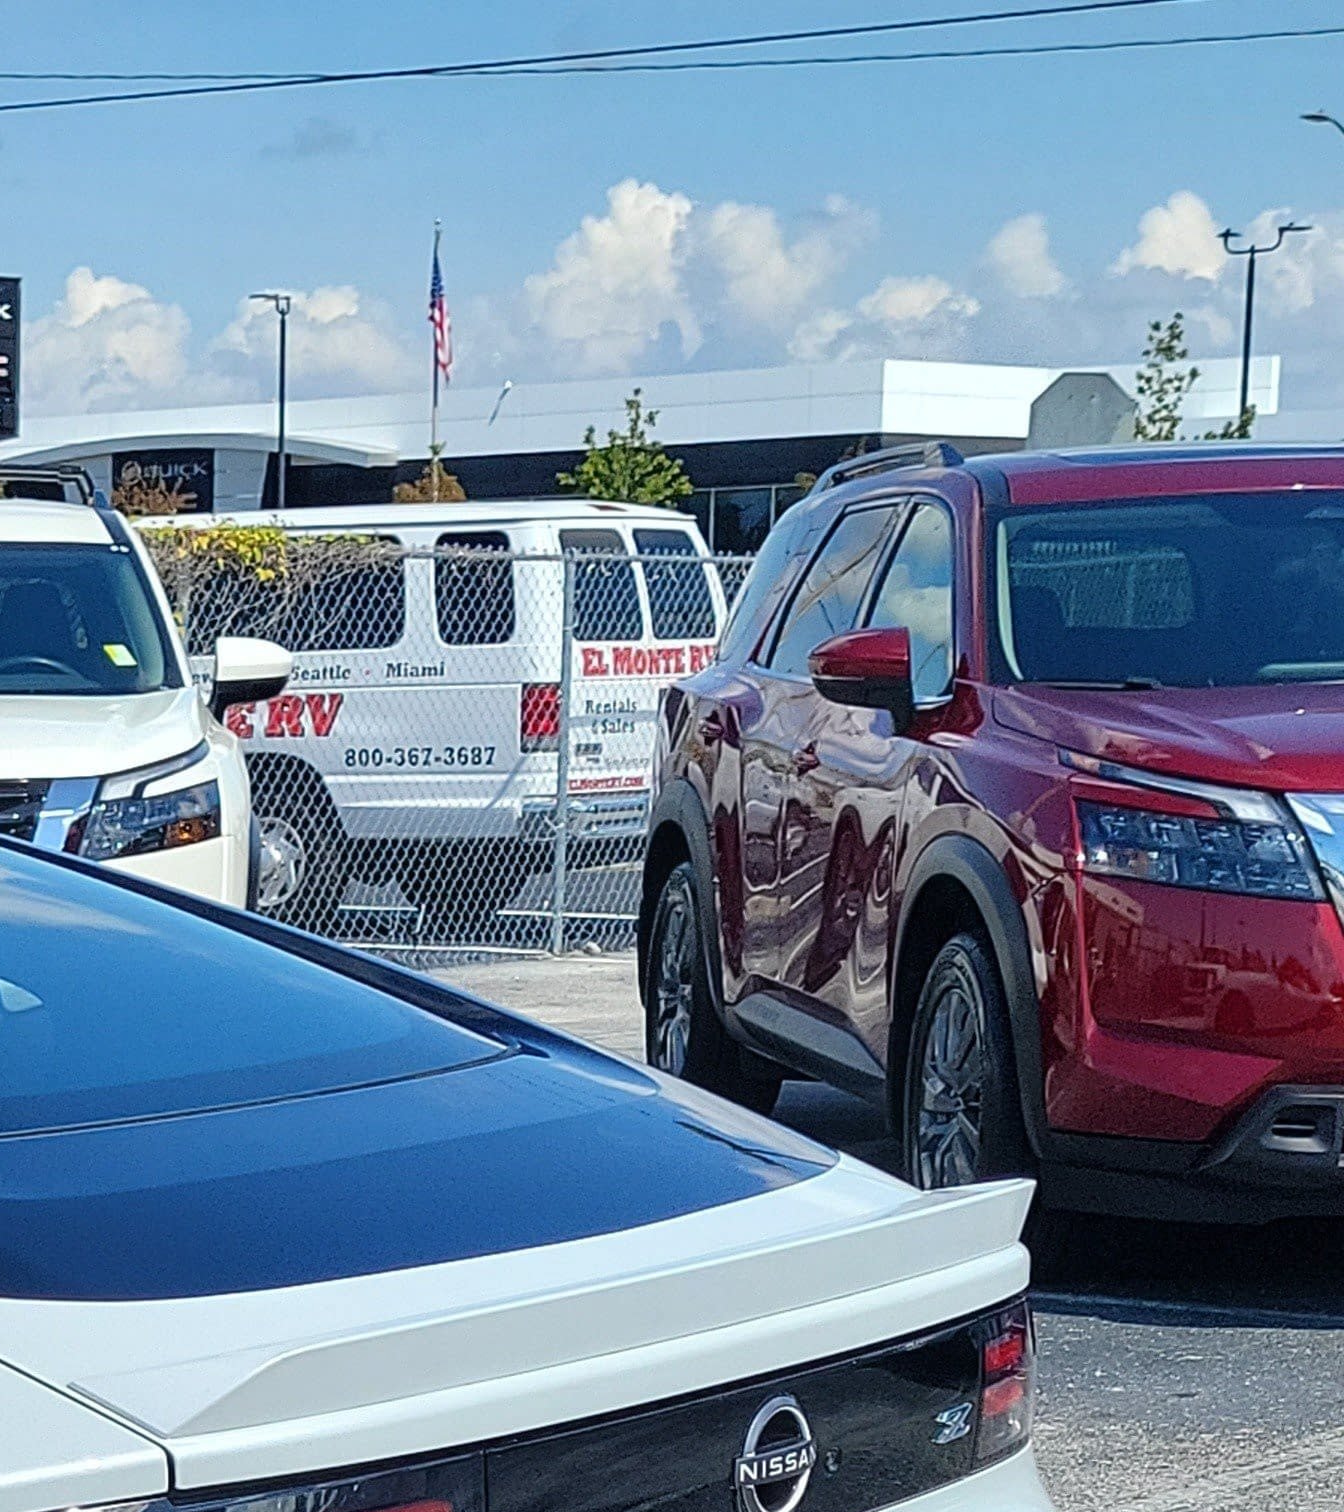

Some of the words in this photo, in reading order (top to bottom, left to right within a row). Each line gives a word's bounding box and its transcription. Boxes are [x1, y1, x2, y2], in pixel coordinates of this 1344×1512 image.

[291, 664, 351, 681] Seattle
[386, 661, 445, 678] Miami
[582, 648, 609, 676] EL
[612, 646, 685, 676] MONTE
[265, 693, 344, 738] RV
[585, 699, 638, 715] Rentals
[344, 746, 496, 767] 800-367-3687
[739, 1446, 817, 1482] NISSA
